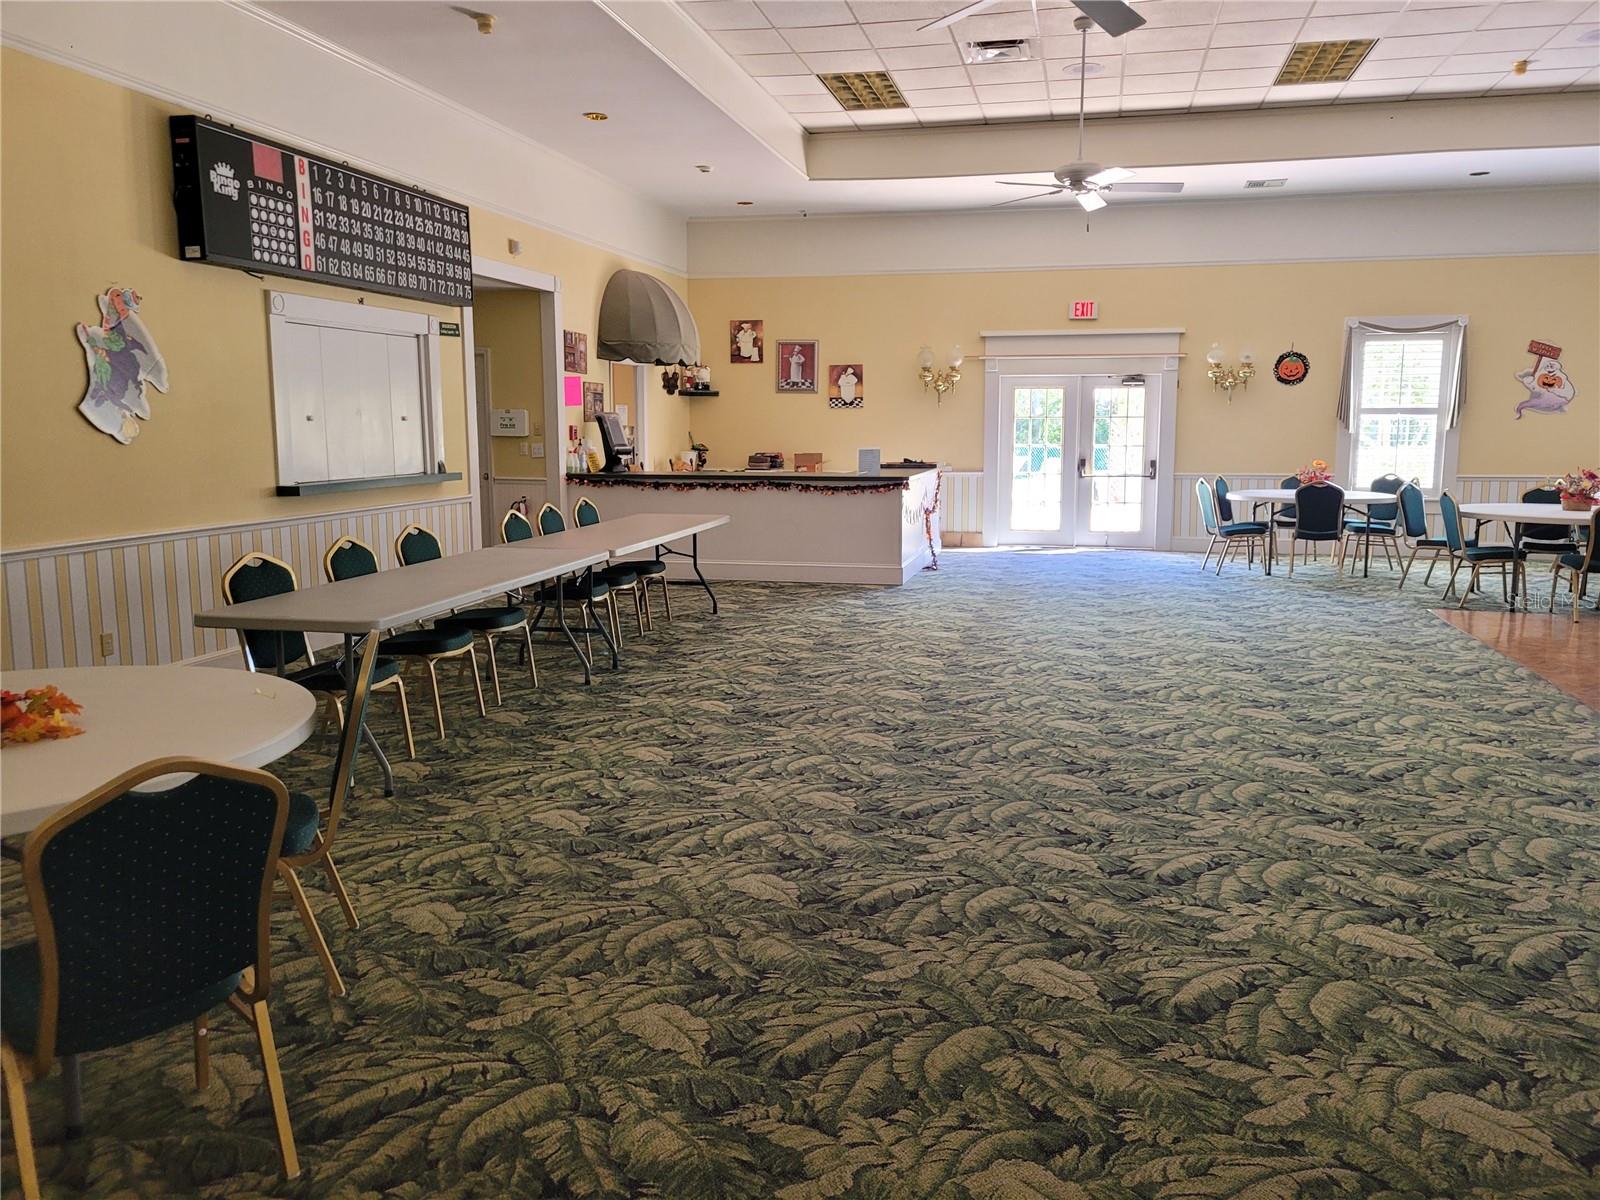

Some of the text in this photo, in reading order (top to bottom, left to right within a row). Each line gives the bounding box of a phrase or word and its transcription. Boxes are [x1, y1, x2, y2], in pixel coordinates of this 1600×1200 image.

[209, 169, 240, 189] Bingo
[214, 180, 239, 201] King
[247, 180, 293, 199] BINGO
[312, 165, 467, 226] 1 2 3 4 5 6 7 8 9 10 11 12 13 14 15
[298, 159, 312, 271] BINGO
[312, 186, 469, 244] 16 17 18 19 20 21 22 23 24 25 26 27 28 29 30
[314, 209, 470, 263] 31 32 33 34 35 36 37 38 39 40 41 42 43 44 45
[315, 232, 471, 281] 46 47 48 49 50 51 52 53 54 55 56 57 58 59 60
[316, 256, 472, 299] 61 62 63 64 65 66 67 68 69 70 71 72 73 74 75
[1074, 302, 1094, 317] EXIT
